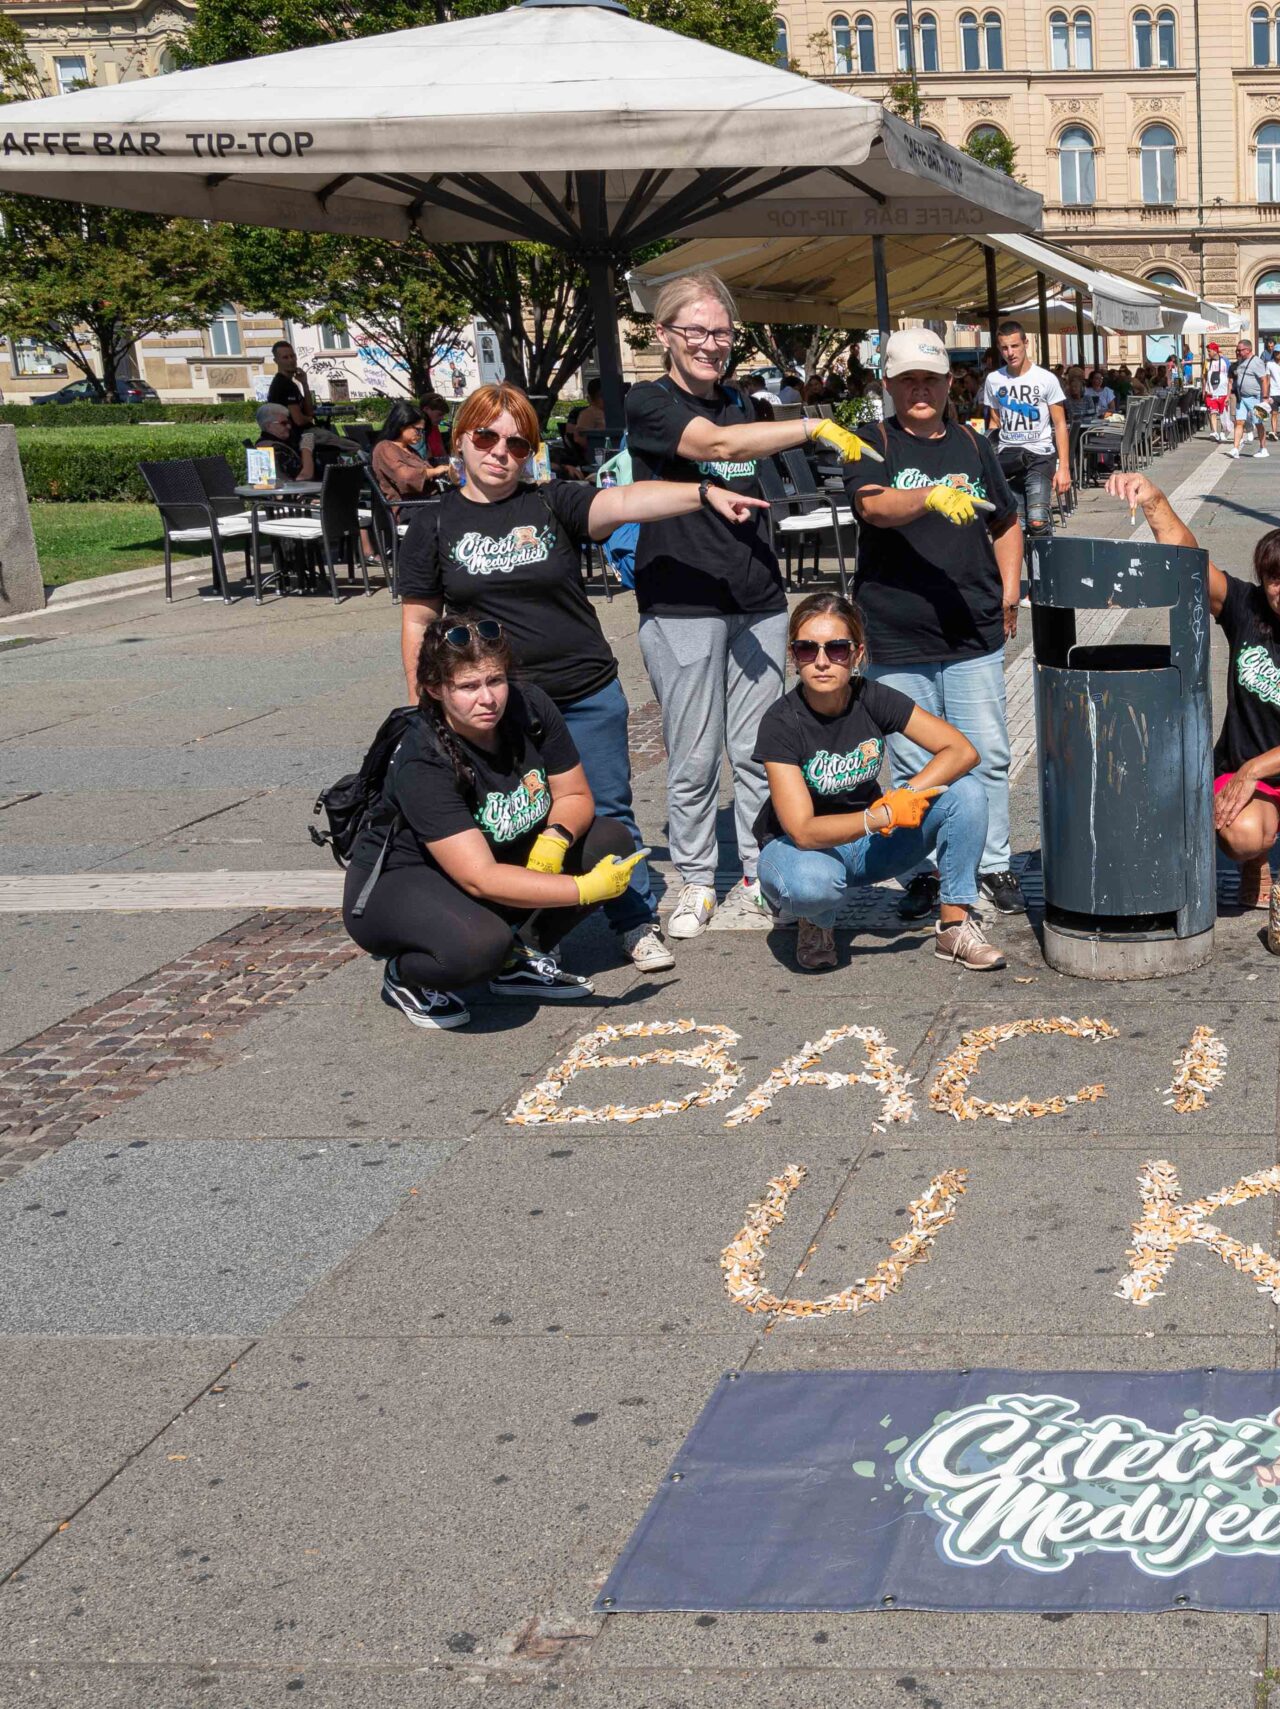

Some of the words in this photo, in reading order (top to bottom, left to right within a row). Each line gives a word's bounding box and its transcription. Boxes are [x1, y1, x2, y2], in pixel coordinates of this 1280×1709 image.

[2, 132, 87, 156] AFFE
[92, 131, 167, 157] BAR
[185, 131, 314, 159] TIP-TOP
[505, 1015, 1229, 1127] BACI
[720, 1163, 969, 1319] U
